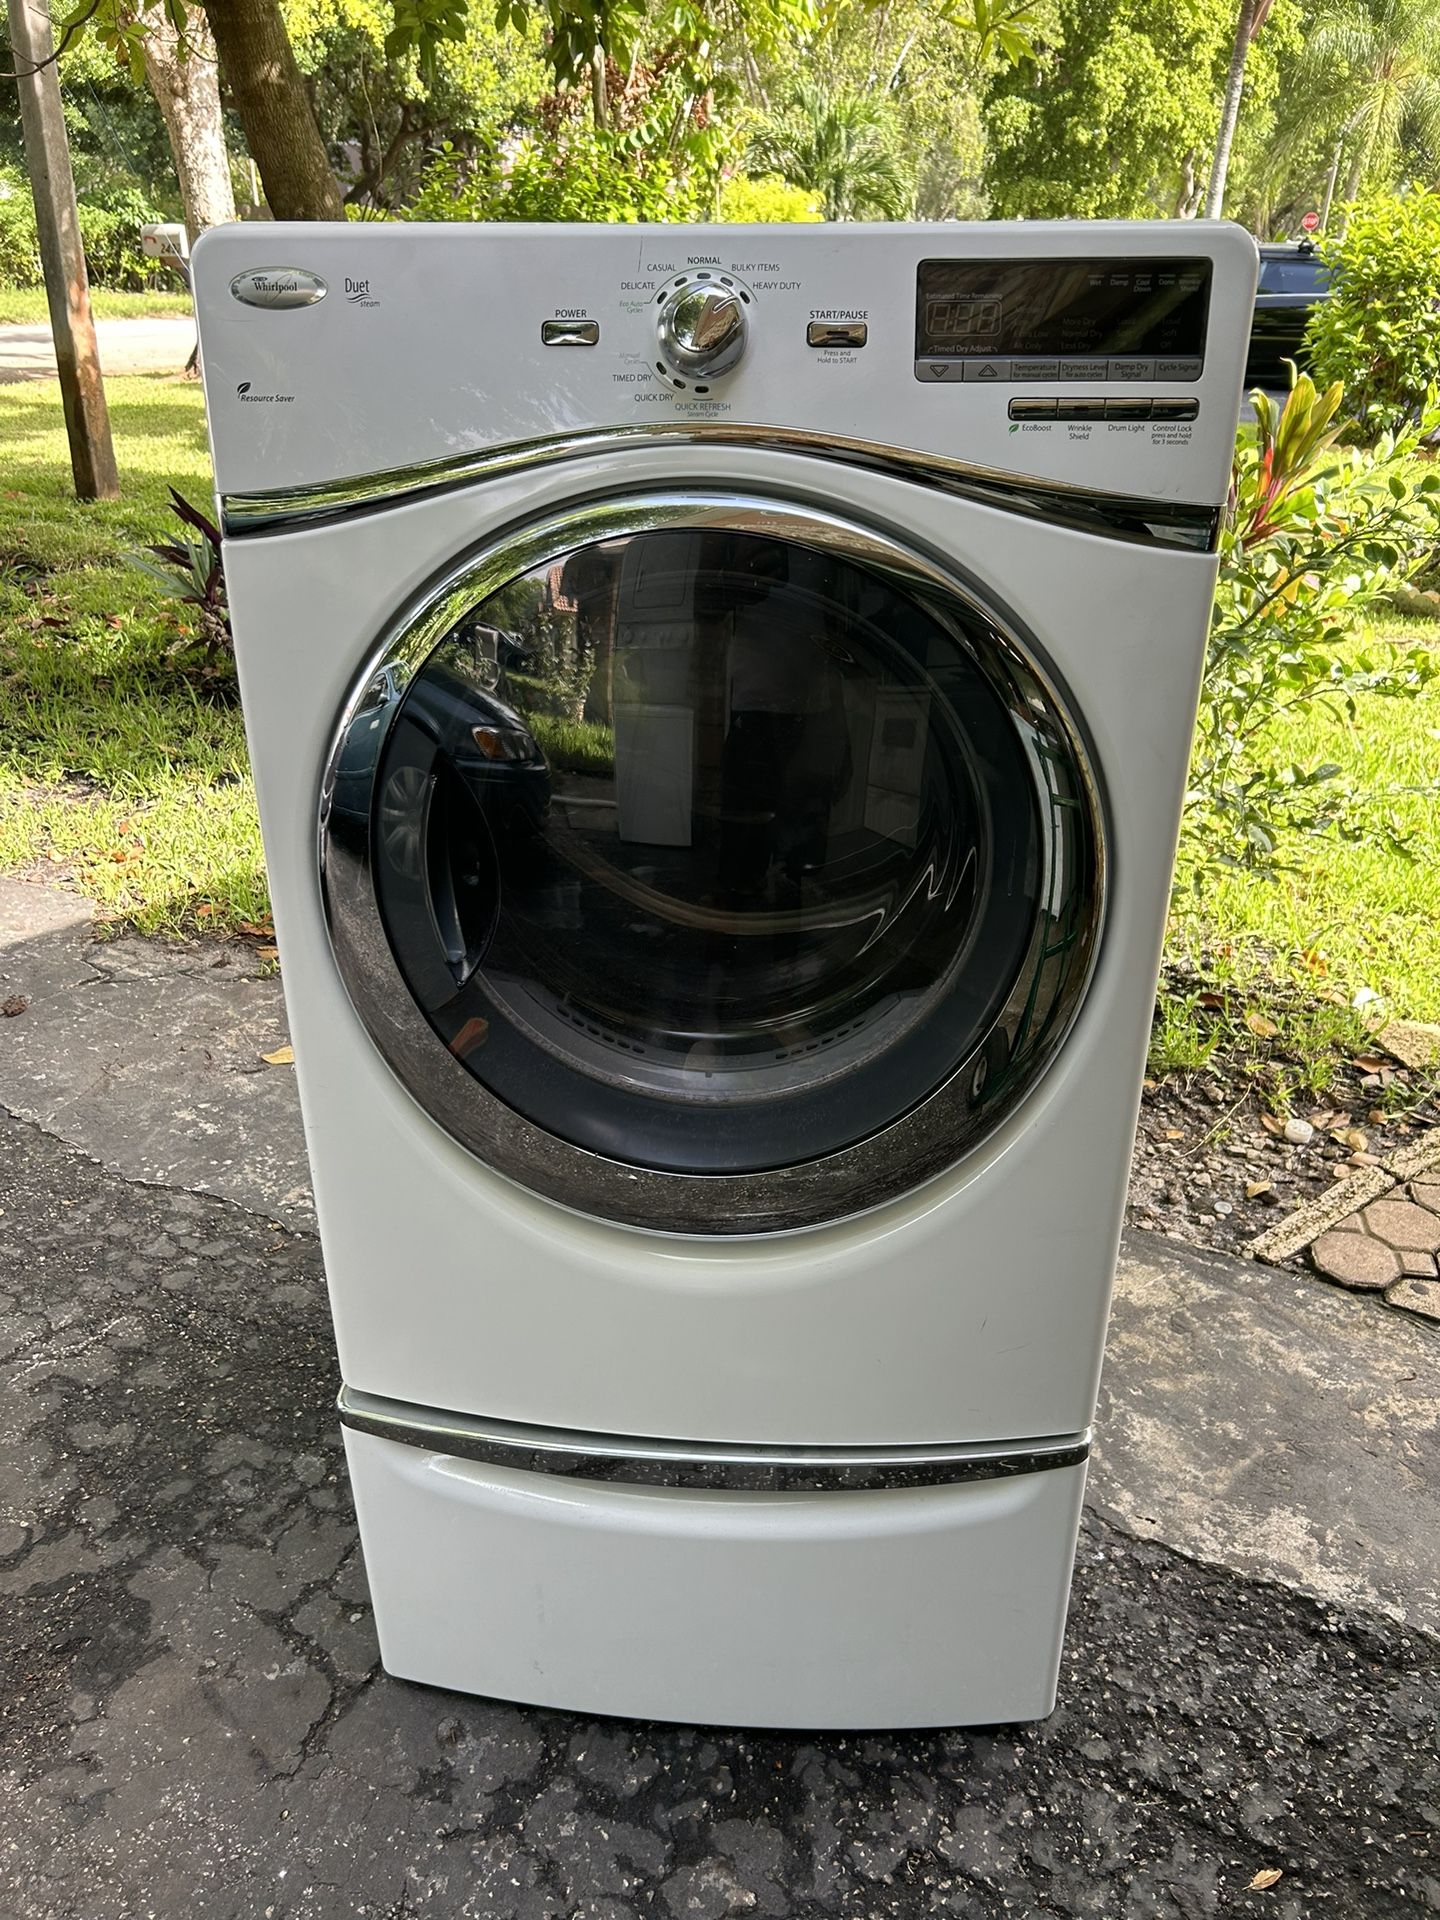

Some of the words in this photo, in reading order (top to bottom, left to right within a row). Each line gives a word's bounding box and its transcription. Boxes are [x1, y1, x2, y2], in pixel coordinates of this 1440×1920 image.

[687, 256, 722, 265] NORMAL
[647, 264, 676, 272] CASUAL
[731, 264, 756, 272] BULKY
[757, 264, 780, 272] ITEMS
[254, 281, 298, 294] Whirlpool
[345, 277, 370, 293] Duet
[621, 281, 656, 290] DELICATE
[752, 281, 779, 290] HEAVY
[779, 281, 801, 290] DUTY
[360, 300, 381, 308] steam
[555, 309, 587, 319] POWER
[810, 310, 869, 320] START/PAUSE
[613, 374, 635, 382] TIMED
[637, 374, 652, 382] DRY
[241, 394, 274, 402] Resource
[275, 394, 295, 402] Saver
[634, 393, 658, 402] QUICK
[659, 393, 674, 401] DRY
[675, 403, 698, 411] QUICK
[700, 403, 731, 411] REFRESH
[1022, 424, 1052, 432] EcoBoost
[1068, 424, 1093, 432] Wrinkle
[1108, 424, 1127, 432] Drum
[1128, 424, 1145, 433] Light
[1152, 424, 1177, 432] Control
[1177, 424, 1192, 432] Lock
